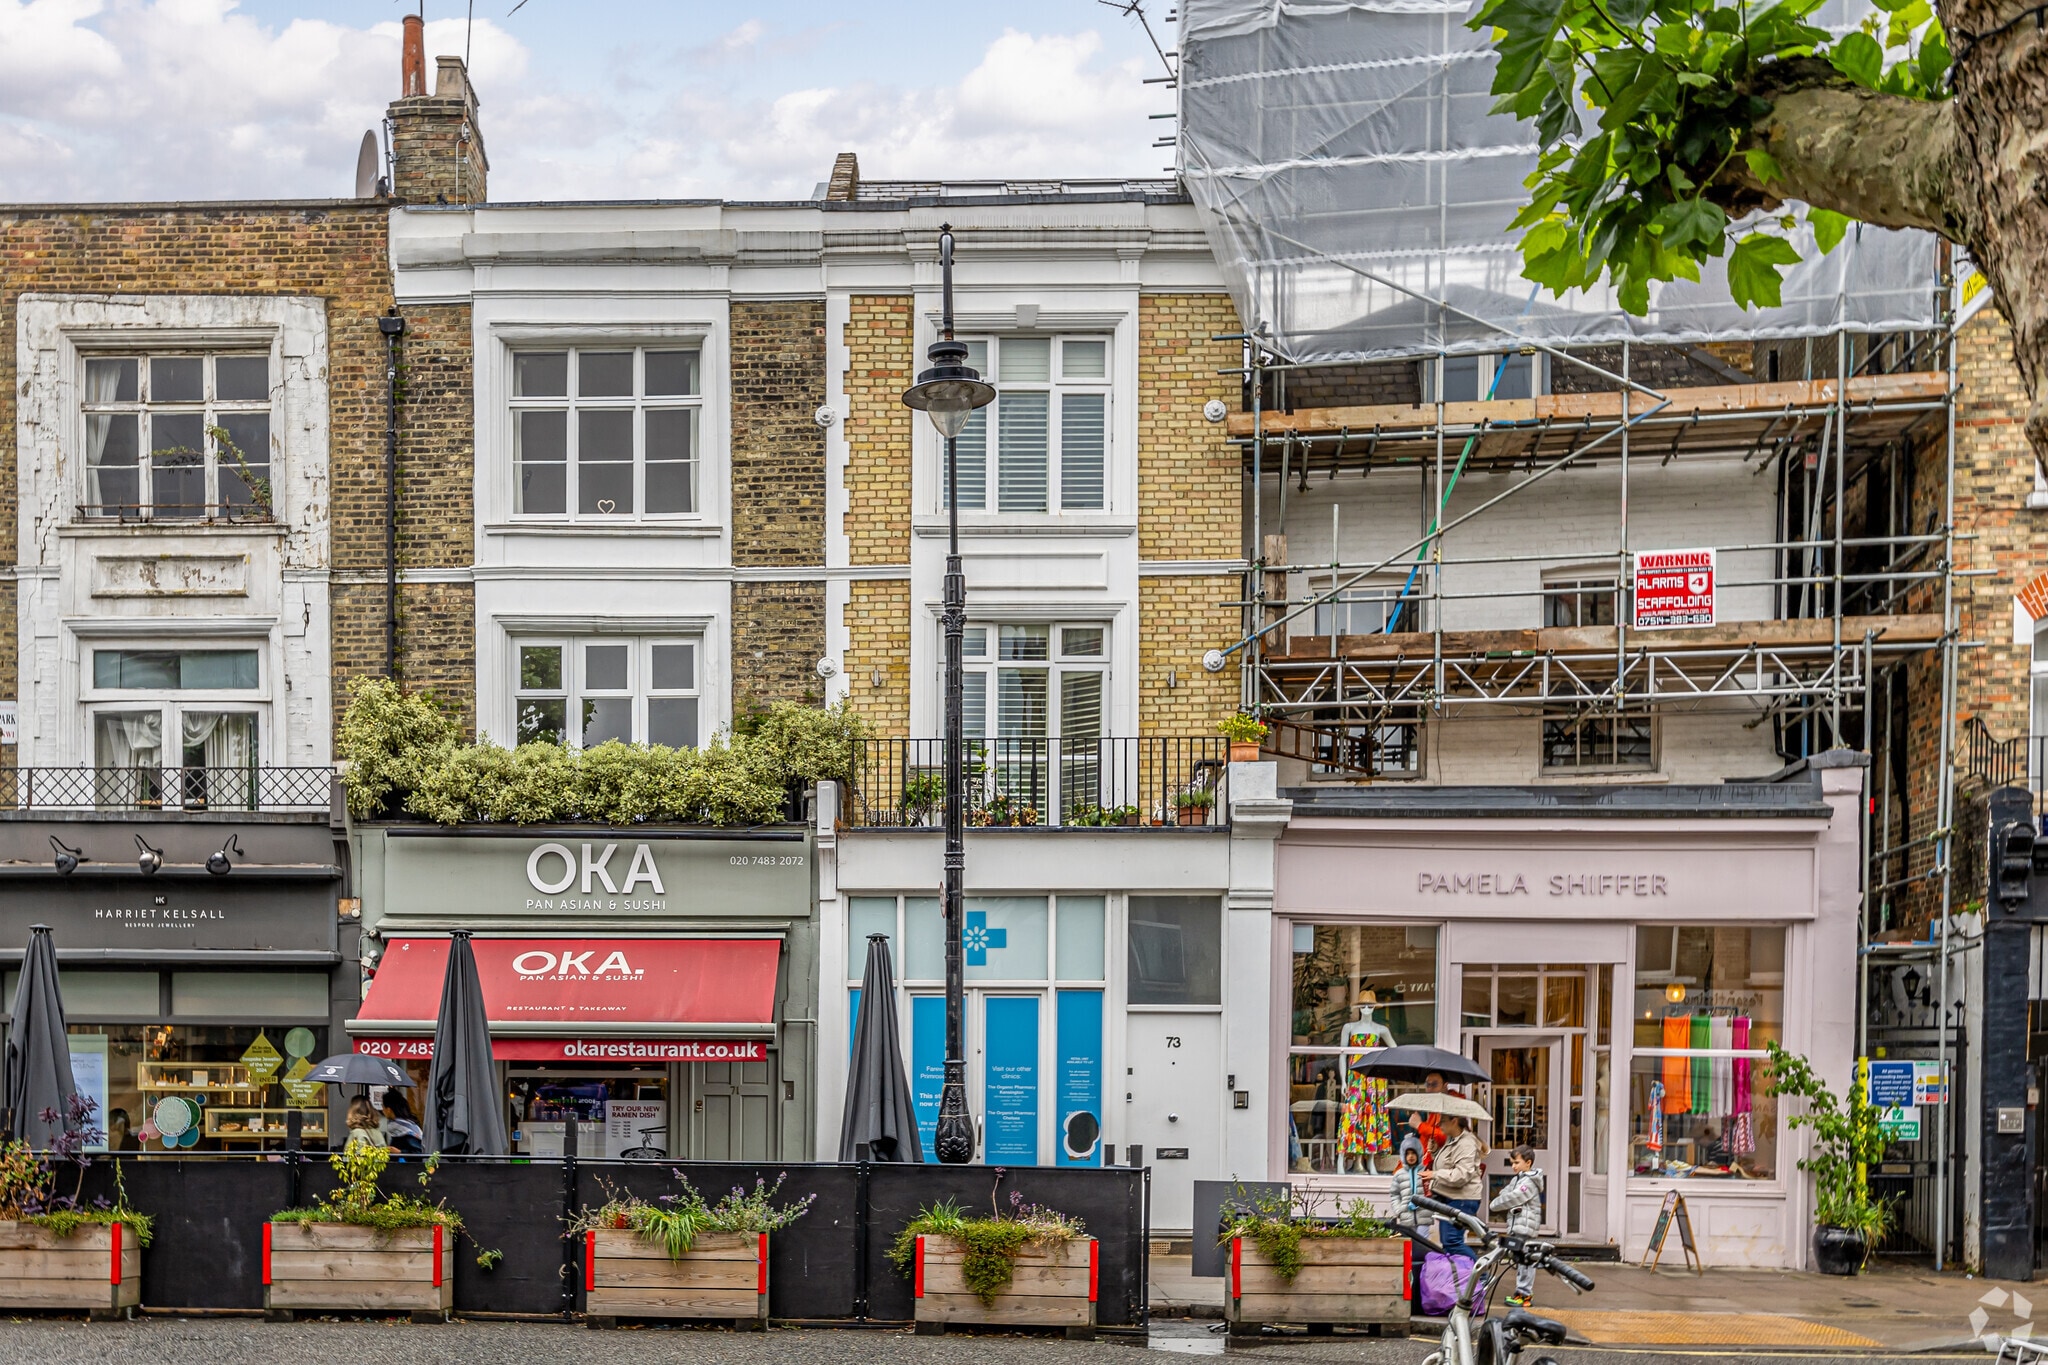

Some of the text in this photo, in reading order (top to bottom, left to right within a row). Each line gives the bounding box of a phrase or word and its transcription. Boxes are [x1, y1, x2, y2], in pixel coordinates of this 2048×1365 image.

[1639, 552, 1711, 568] WARNING
[1638, 576, 1704, 590] ALARMS 4
[1638, 594, 1712, 610] SCAFFOLDING
[729, 856, 804, 866] 020 7483 2072
[526, 842, 666, 895] OKA
[1418, 871, 1669, 897] PAMELA SHIFFER
[526, 899, 666, 911] PAN ASIAN & SUSHI
[95, 909, 225, 919] HARRIET KELSALL
[360, 1041, 391, 1055] 020
[563, 1040, 759, 1058] okarestaurant.co.uk
[1166, 1036, 1181, 1048] 73
[730, 1085, 739, 1095] 71
